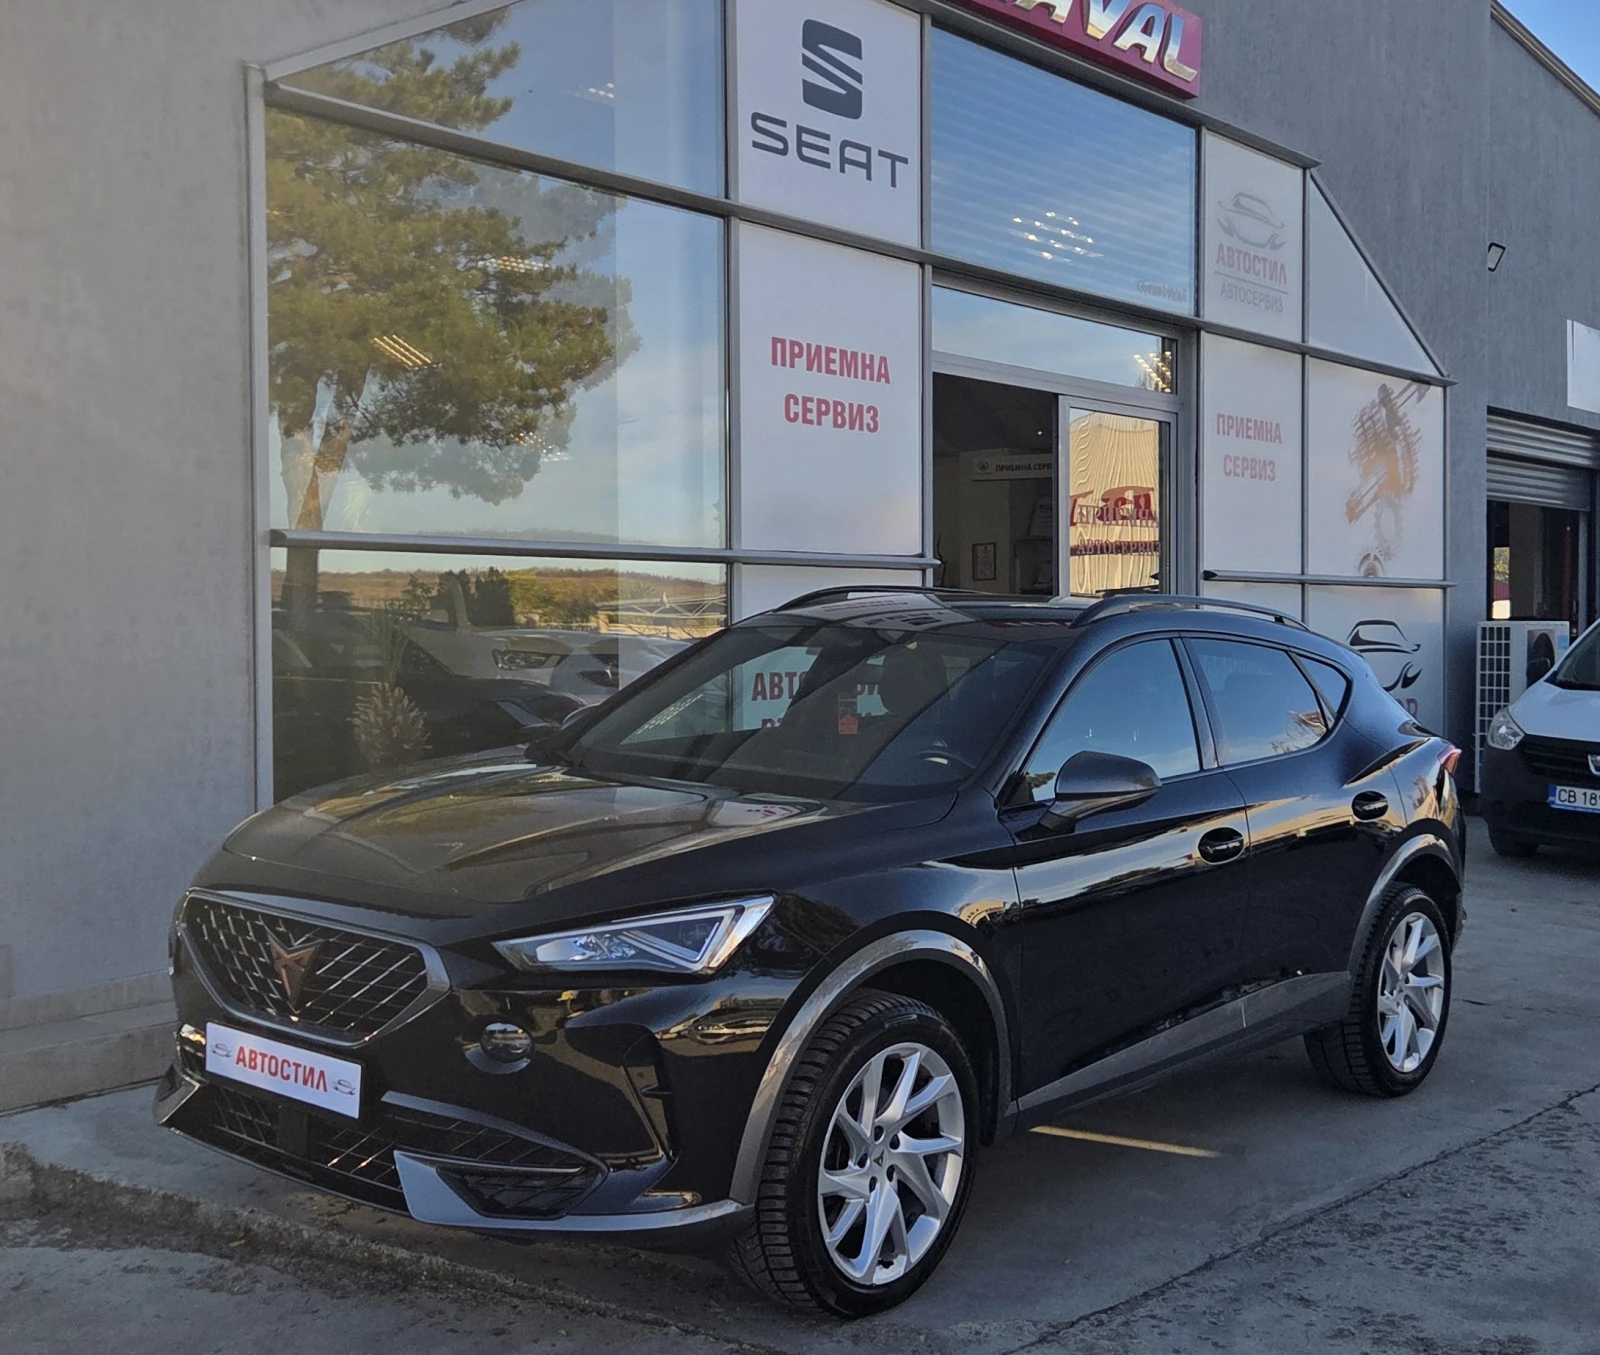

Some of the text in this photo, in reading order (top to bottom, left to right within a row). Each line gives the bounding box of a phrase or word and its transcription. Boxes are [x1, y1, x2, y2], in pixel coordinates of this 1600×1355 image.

[751, 111, 909, 189] SEAT
[1216, 243, 1287, 285] АВТОСТИЛ
[1220, 281, 1284, 314] АВТОСЕРВИЗ
[771, 336, 891, 384] ПРИЕМНА
[784, 393, 879, 433] СЕРВИЗ
[1216, 412, 1283, 444] ПРИЕМНА
[995, 463, 1033, 473] ПРИЕМНА
[1223, 454, 1276, 482] СЕРВИЗ
[1582, 791, 1600, 807] 18
[235, 1045, 328, 1093] АВТОСТИЛ
